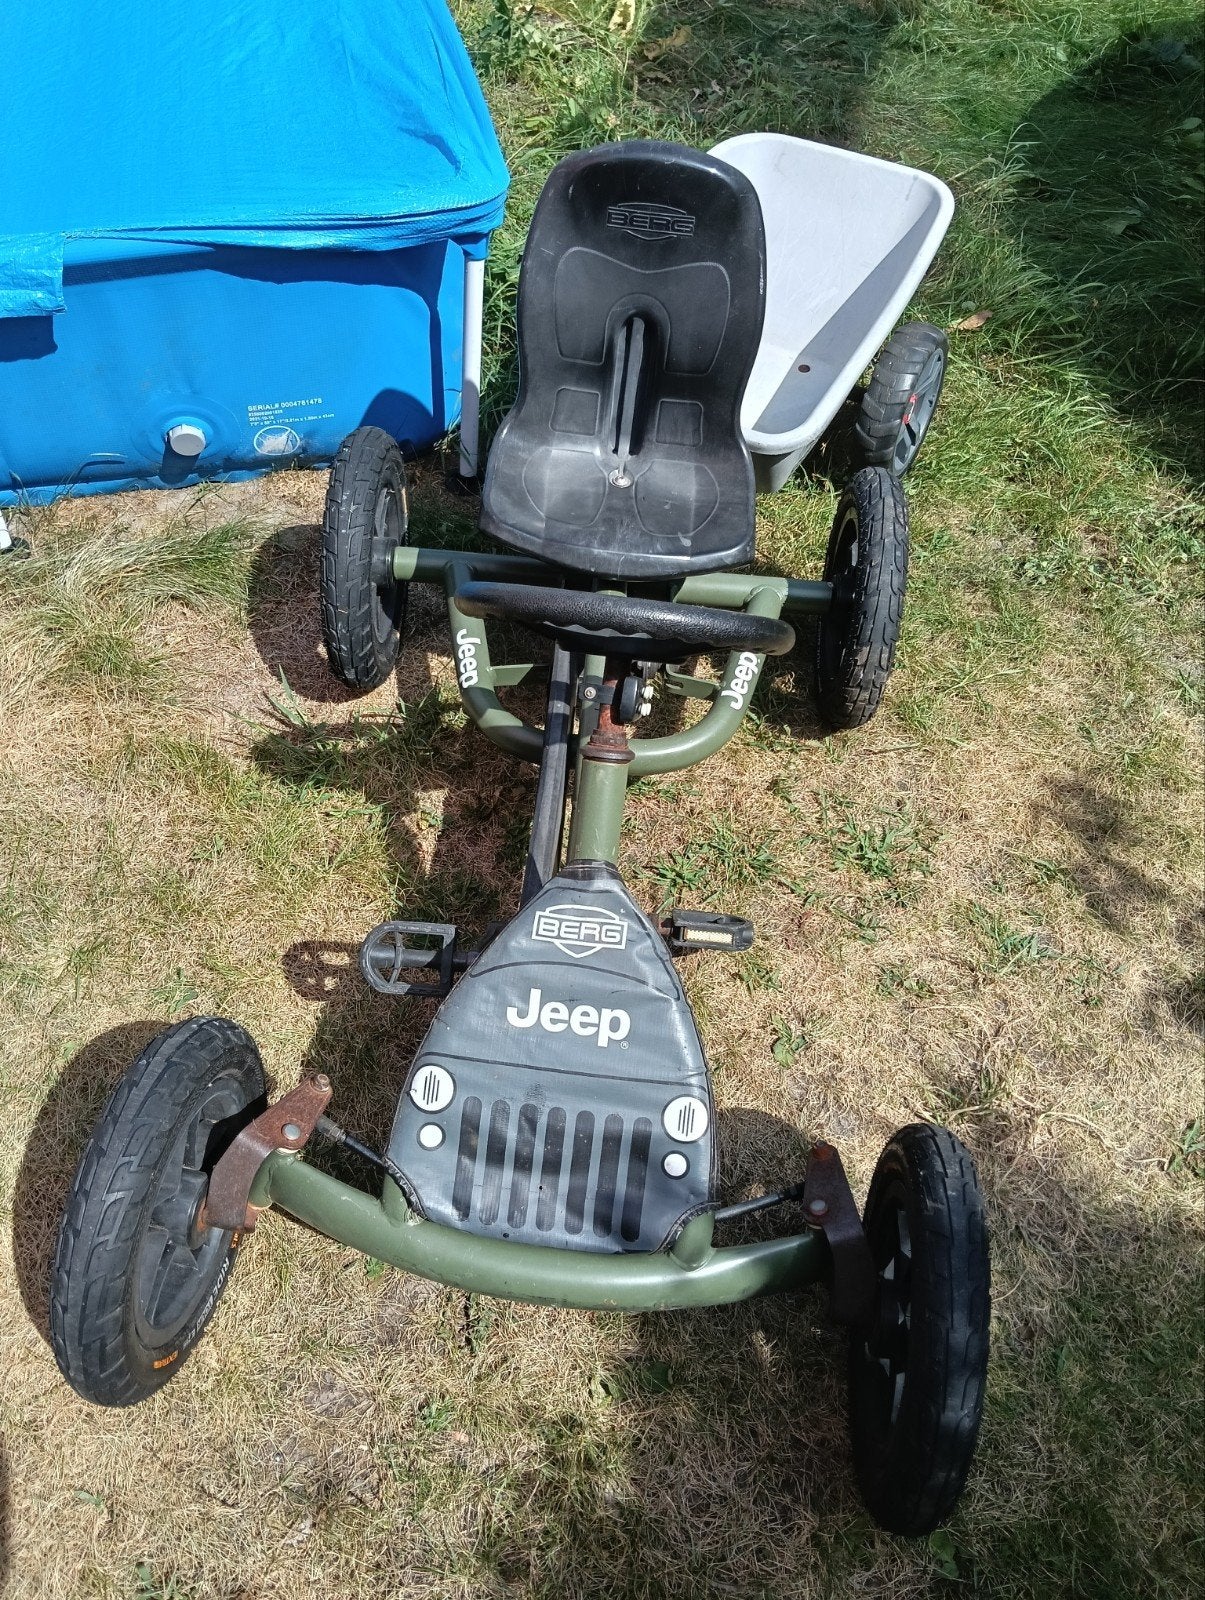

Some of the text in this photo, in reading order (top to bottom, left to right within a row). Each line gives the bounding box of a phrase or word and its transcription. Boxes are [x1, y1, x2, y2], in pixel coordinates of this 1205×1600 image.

[606, 209, 695, 236] BERG
[456, 628, 482, 689] Jeep
[720, 651, 759, 710] Jeep
[537, 916, 623, 944] BERG
[506, 987, 631, 1048] Jeep
